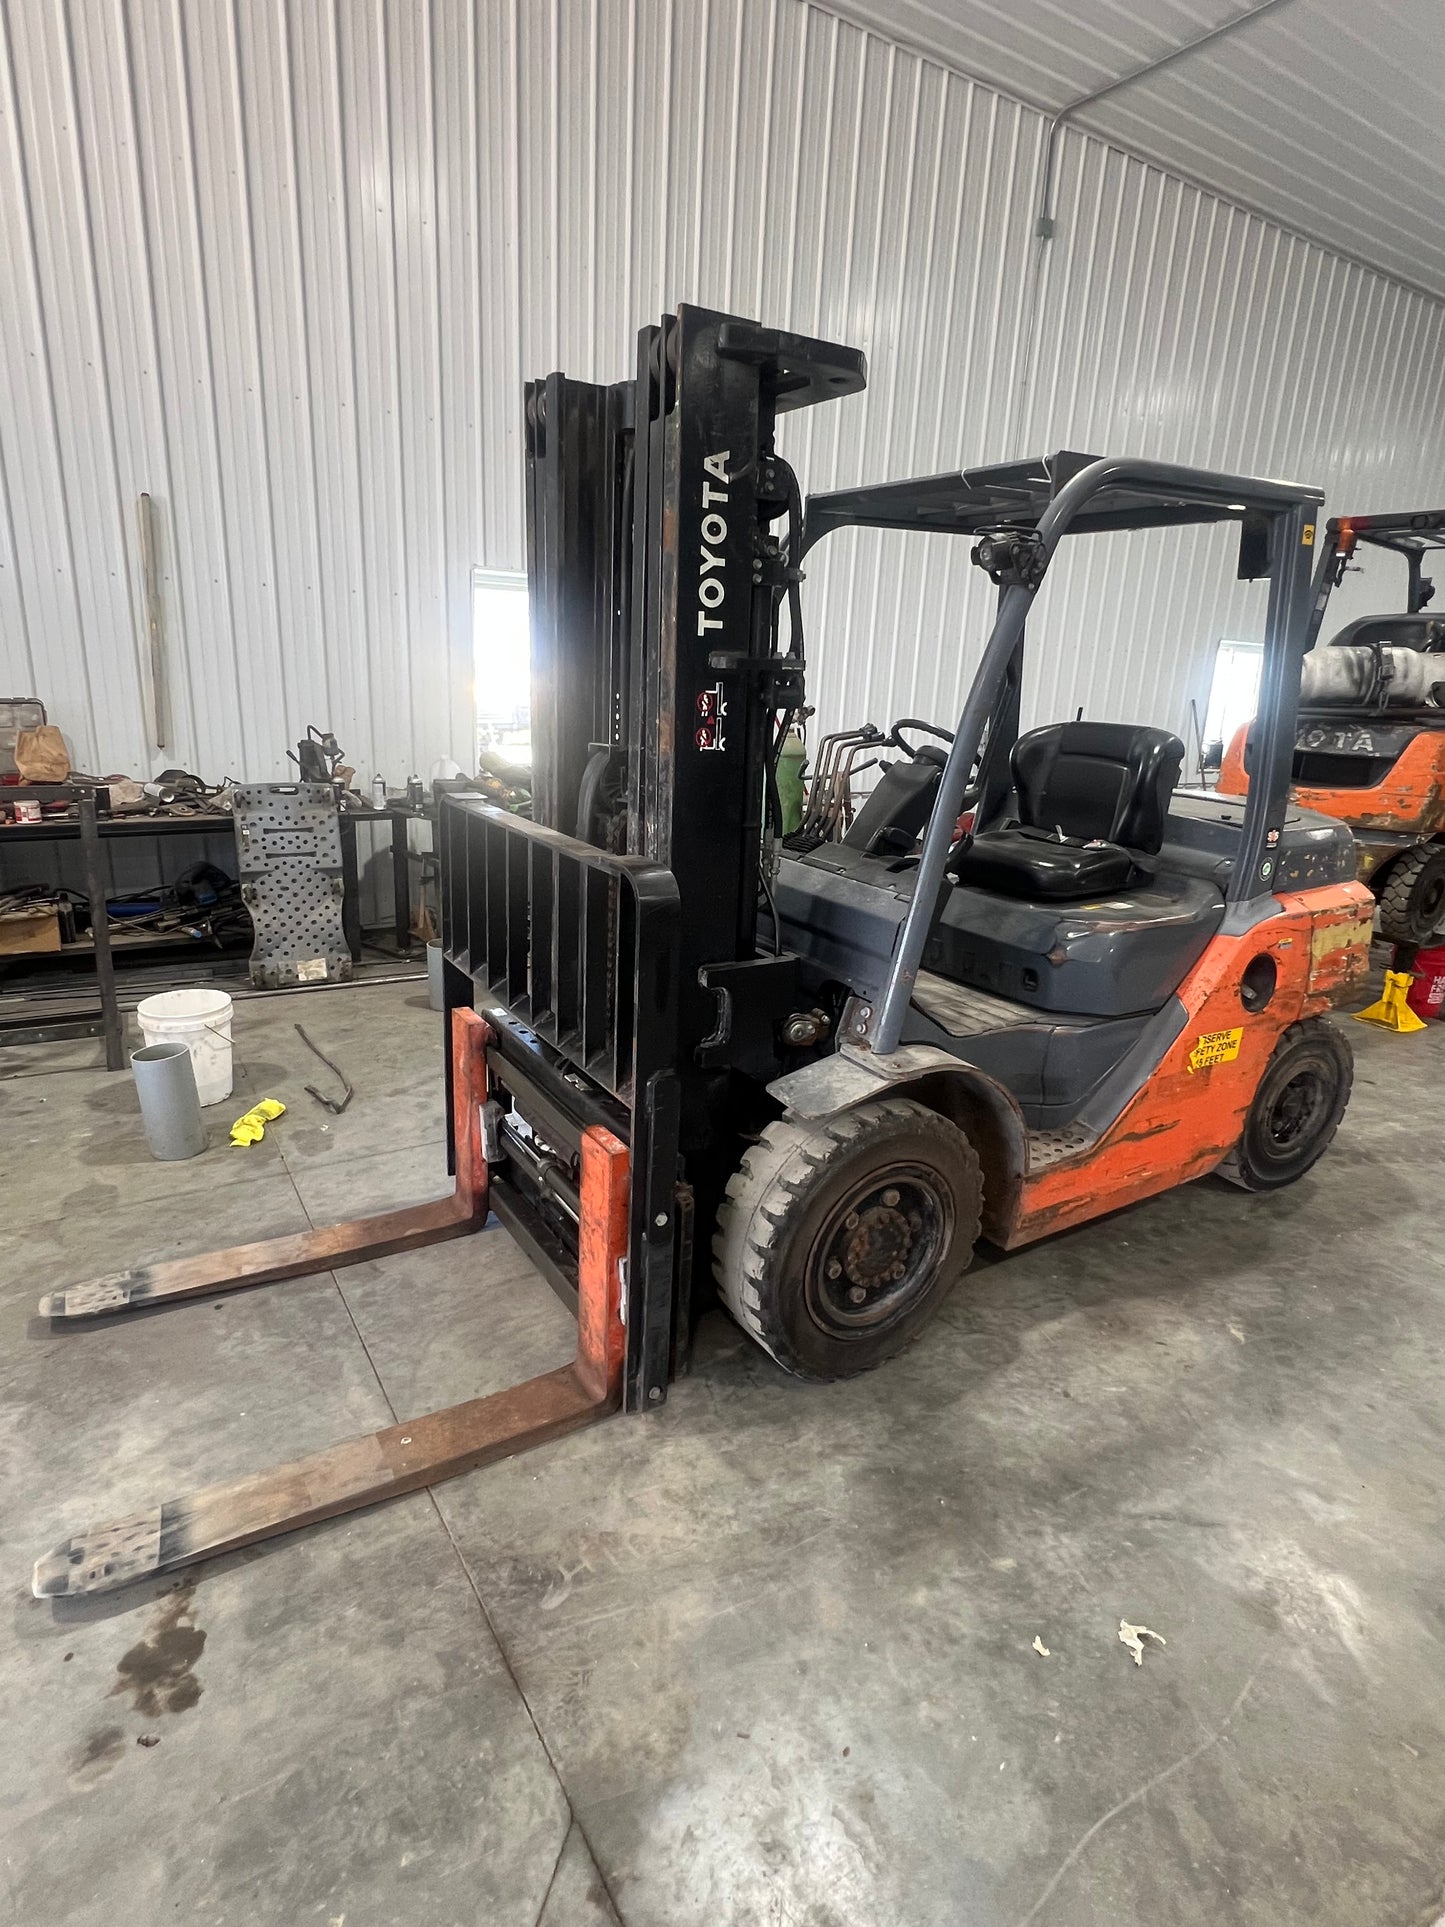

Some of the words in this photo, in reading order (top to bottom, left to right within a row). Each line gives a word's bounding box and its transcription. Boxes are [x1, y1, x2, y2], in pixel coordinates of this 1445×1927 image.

[697, 449, 730, 636] TOYOTA
[1216, 1040, 1237, 1051] ZONE
[1204, 1053, 1224, 1065] FEET
